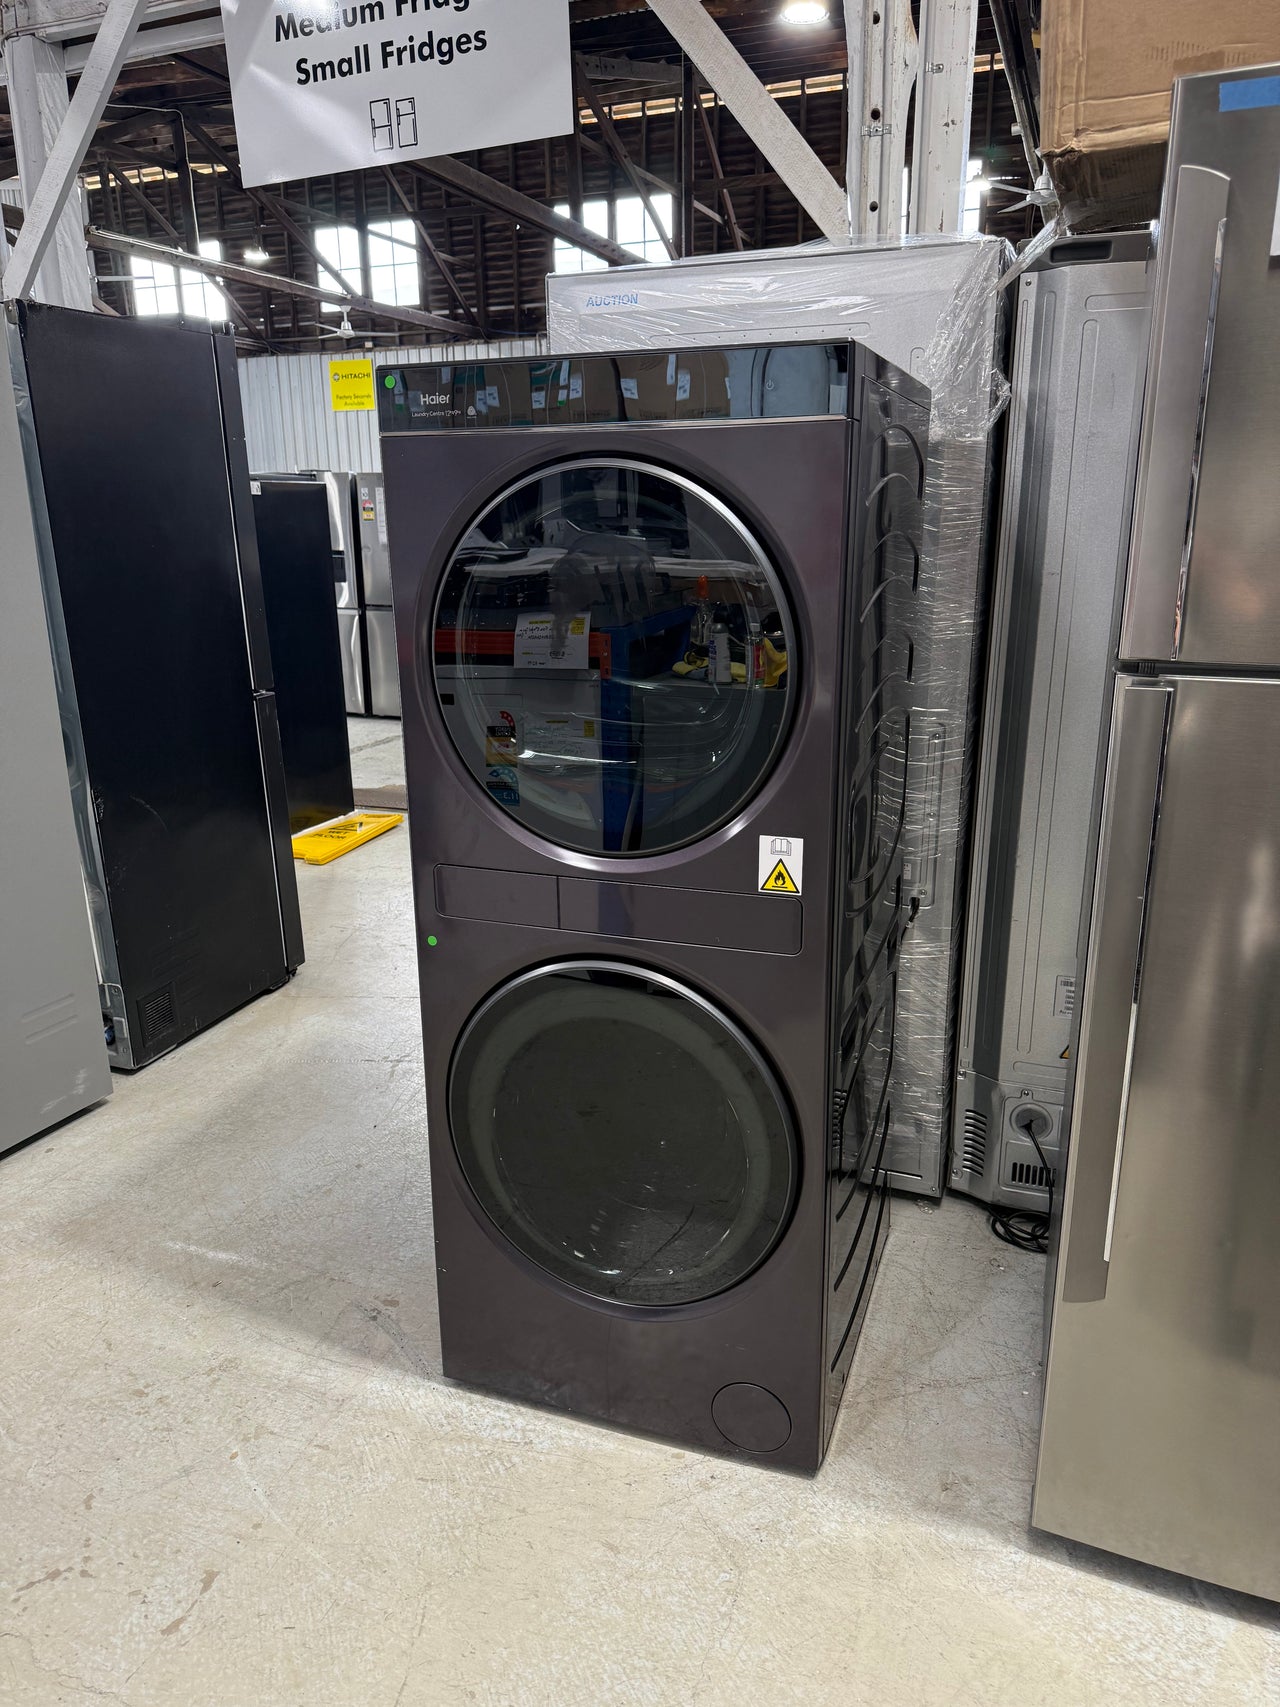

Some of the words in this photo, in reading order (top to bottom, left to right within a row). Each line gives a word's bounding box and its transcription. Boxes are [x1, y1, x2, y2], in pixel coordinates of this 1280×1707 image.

[296, 43, 371, 86] Small
[380, 29, 488, 70] Fridges
[586, 293, 639, 307] AUCTION
[420, 392, 450, 406] Haier
